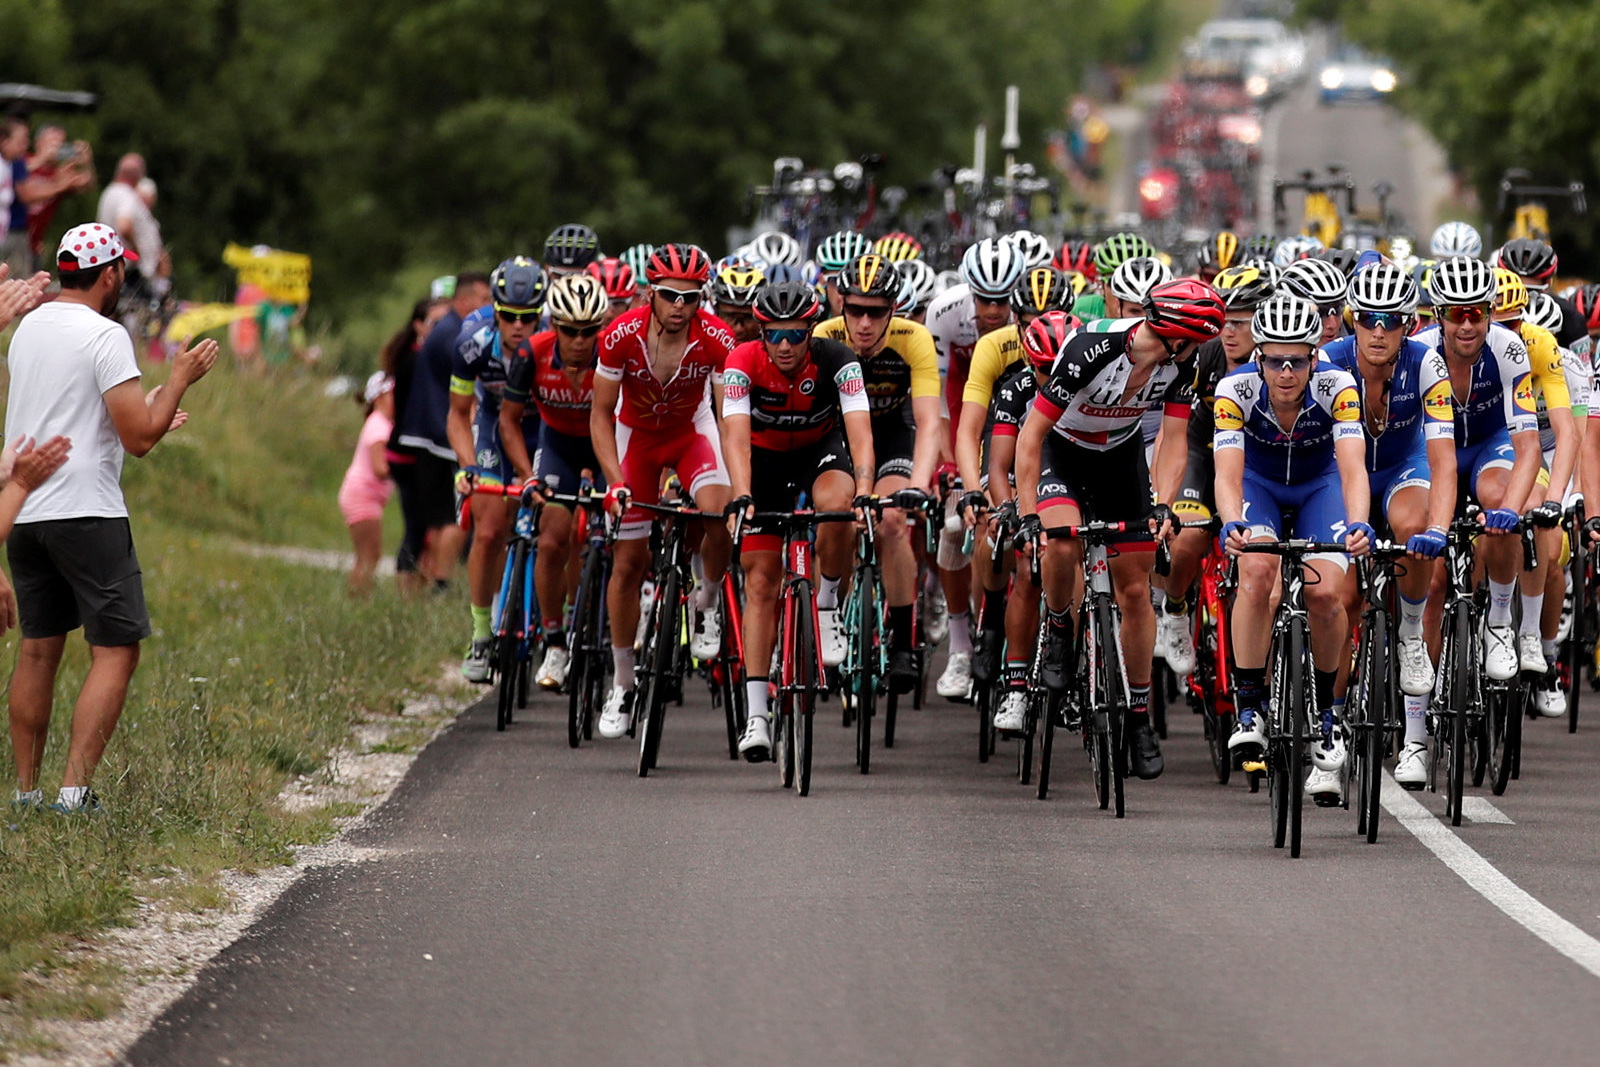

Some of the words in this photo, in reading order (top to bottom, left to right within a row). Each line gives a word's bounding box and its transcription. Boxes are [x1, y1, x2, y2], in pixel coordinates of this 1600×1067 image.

[1083, 338, 1111, 363] UAE
[724, 372, 749, 386] TAG
[839, 366, 863, 383] TAG
